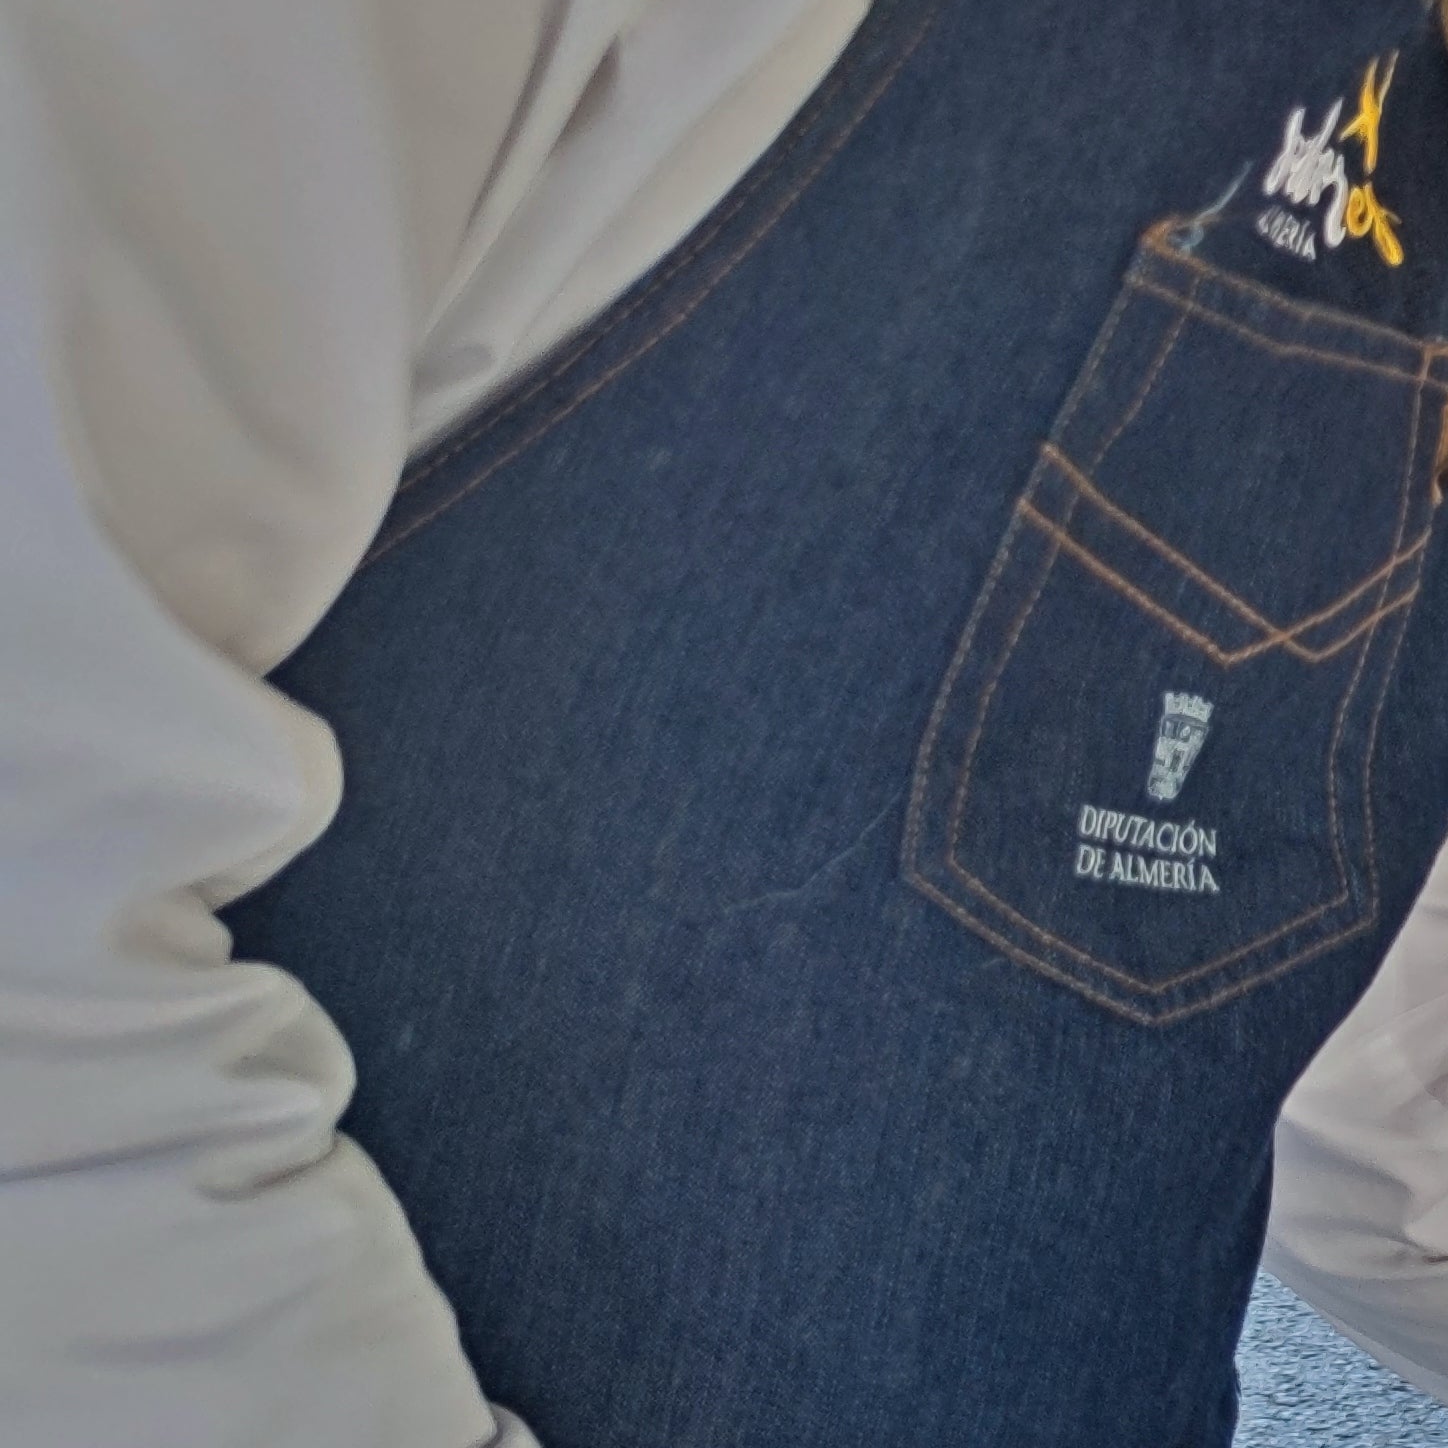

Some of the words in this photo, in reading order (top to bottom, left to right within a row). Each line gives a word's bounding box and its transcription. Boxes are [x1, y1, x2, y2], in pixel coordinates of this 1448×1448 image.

[1080, 805, 1217, 857] DIPUTACIÓN
[1076, 843, 1106, 879] DE
[1109, 852, 1220, 893] ALMERÍA
